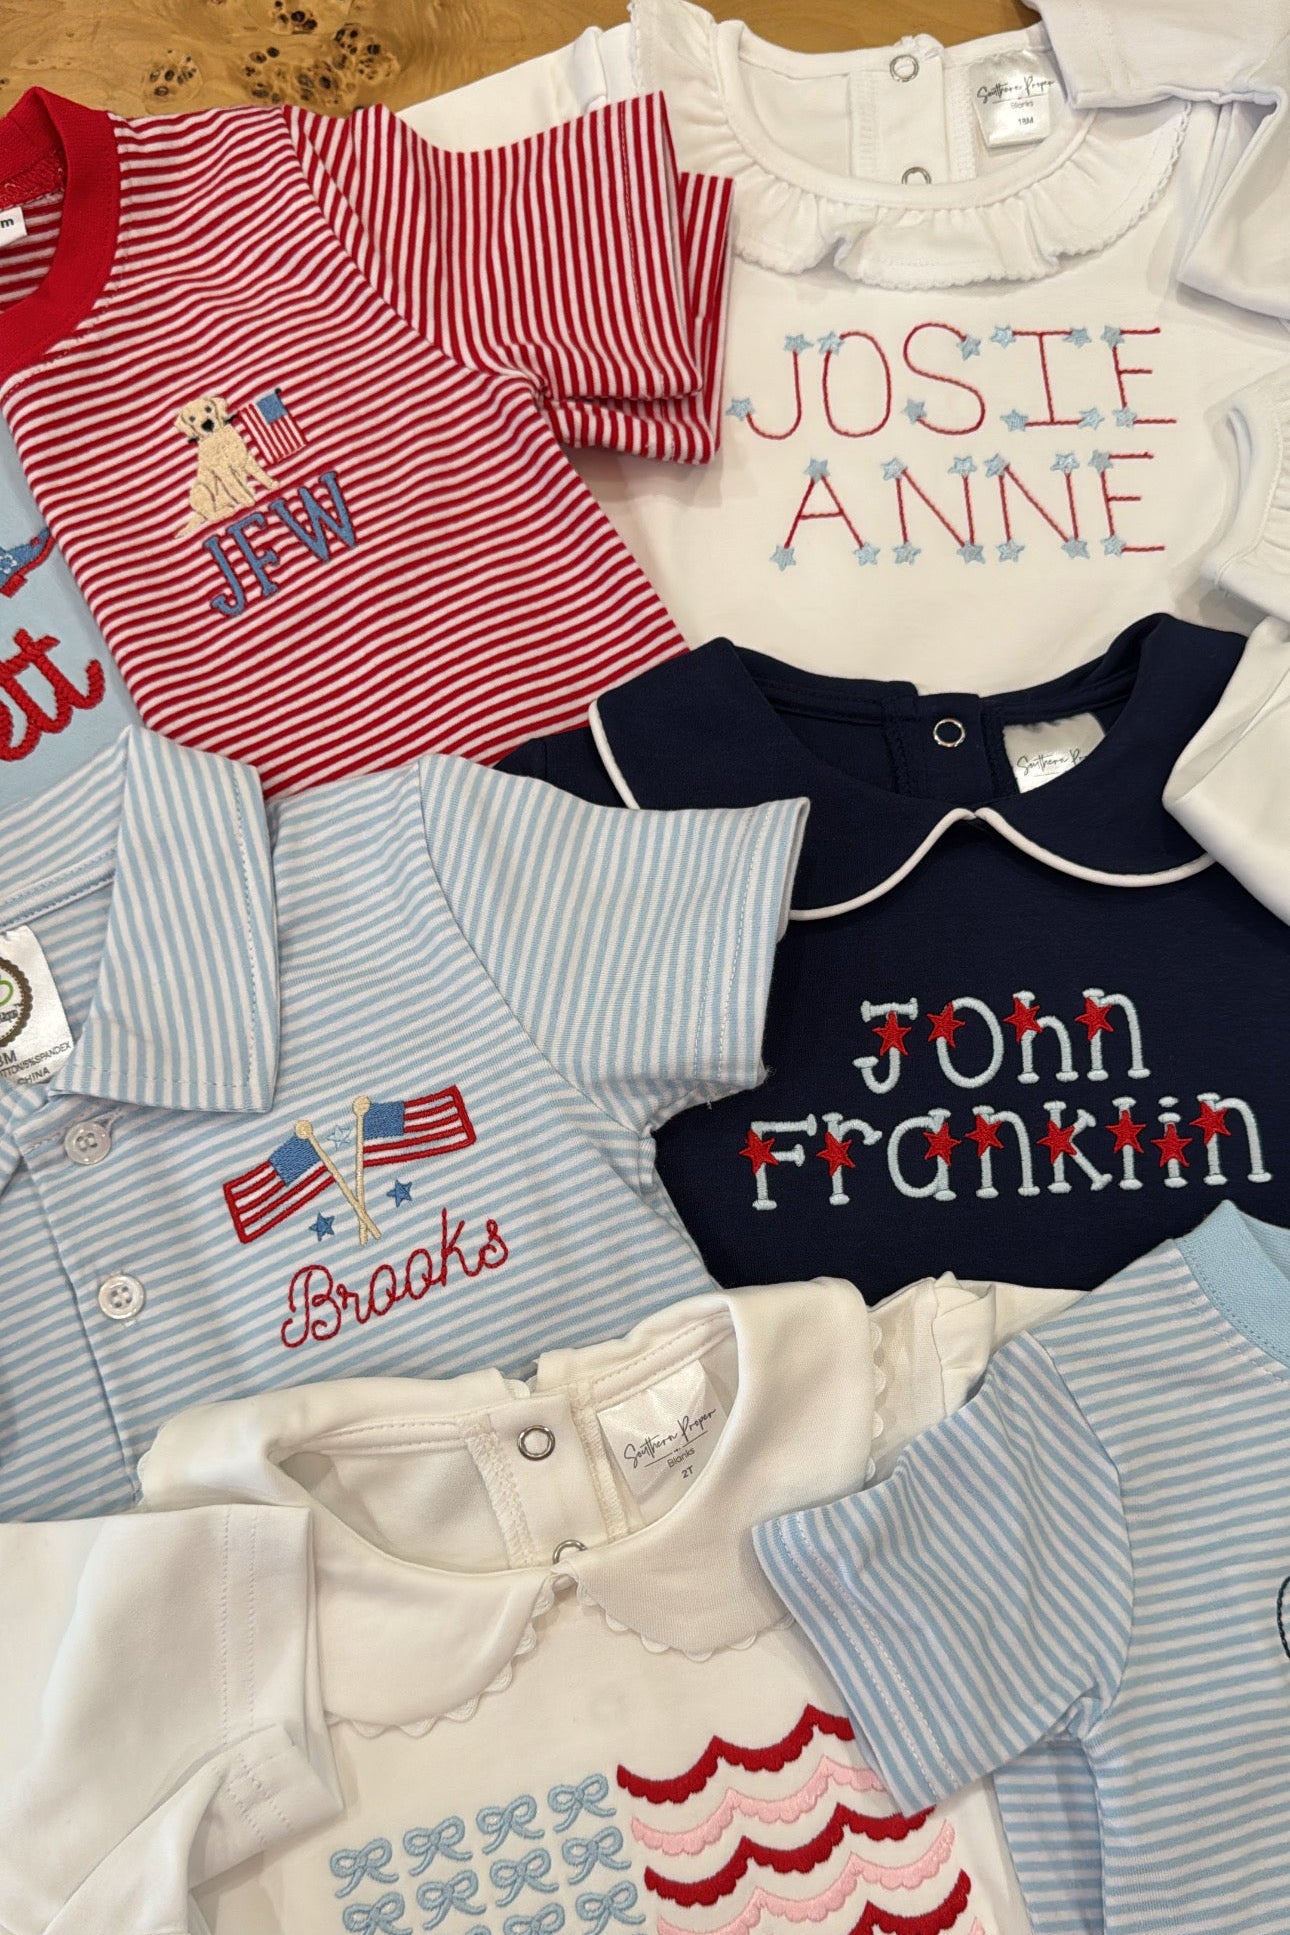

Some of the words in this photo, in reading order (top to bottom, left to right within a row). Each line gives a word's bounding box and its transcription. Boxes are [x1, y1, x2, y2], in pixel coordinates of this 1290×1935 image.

[725, 322, 1177, 440] JOSIE
[202, 470, 358, 617] JFW
[769, 448, 1165, 571] ANNE
[1017, 754, 1068, 775] Southern
[738, 1092, 1272, 1210] Franklin
[280, 1207, 509, 1348] Brooks
[623, 1433, 678, 1469] Southern
[677, 1409, 717, 1442] Proper
[667, 1448, 696, 1468] Blanks
[681, 1465, 694, 1479] 2T
